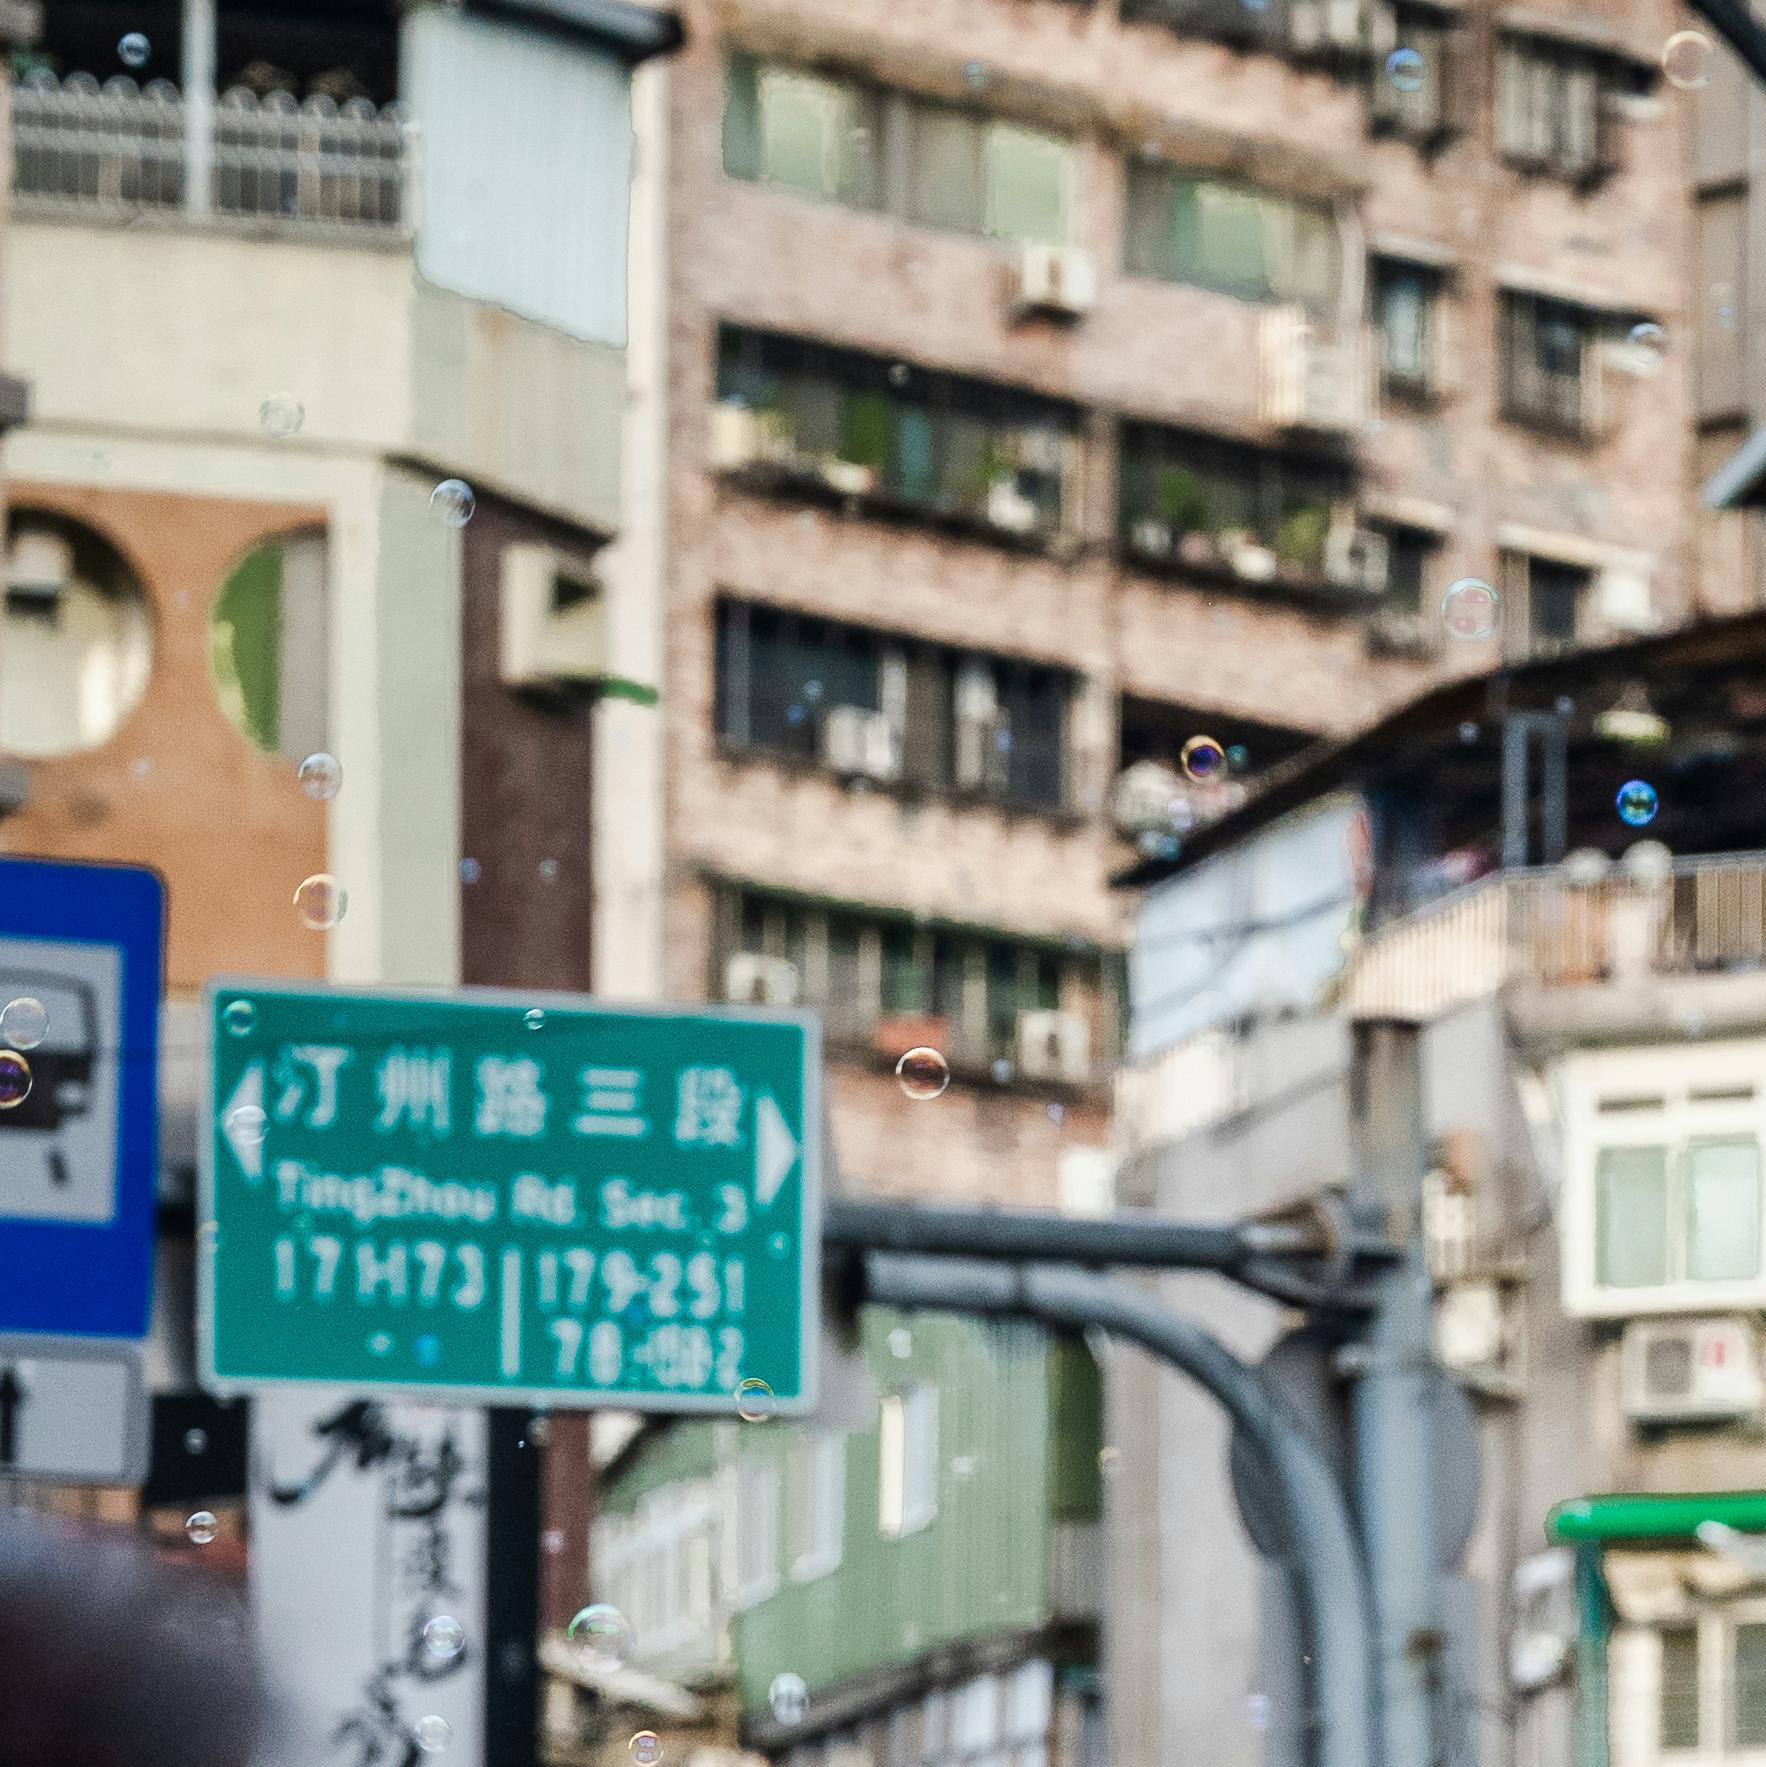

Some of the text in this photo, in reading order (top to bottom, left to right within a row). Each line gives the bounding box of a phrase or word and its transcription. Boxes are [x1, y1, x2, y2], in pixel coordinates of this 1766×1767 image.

[275, 1044, 744, 1147] 汀州路三段
